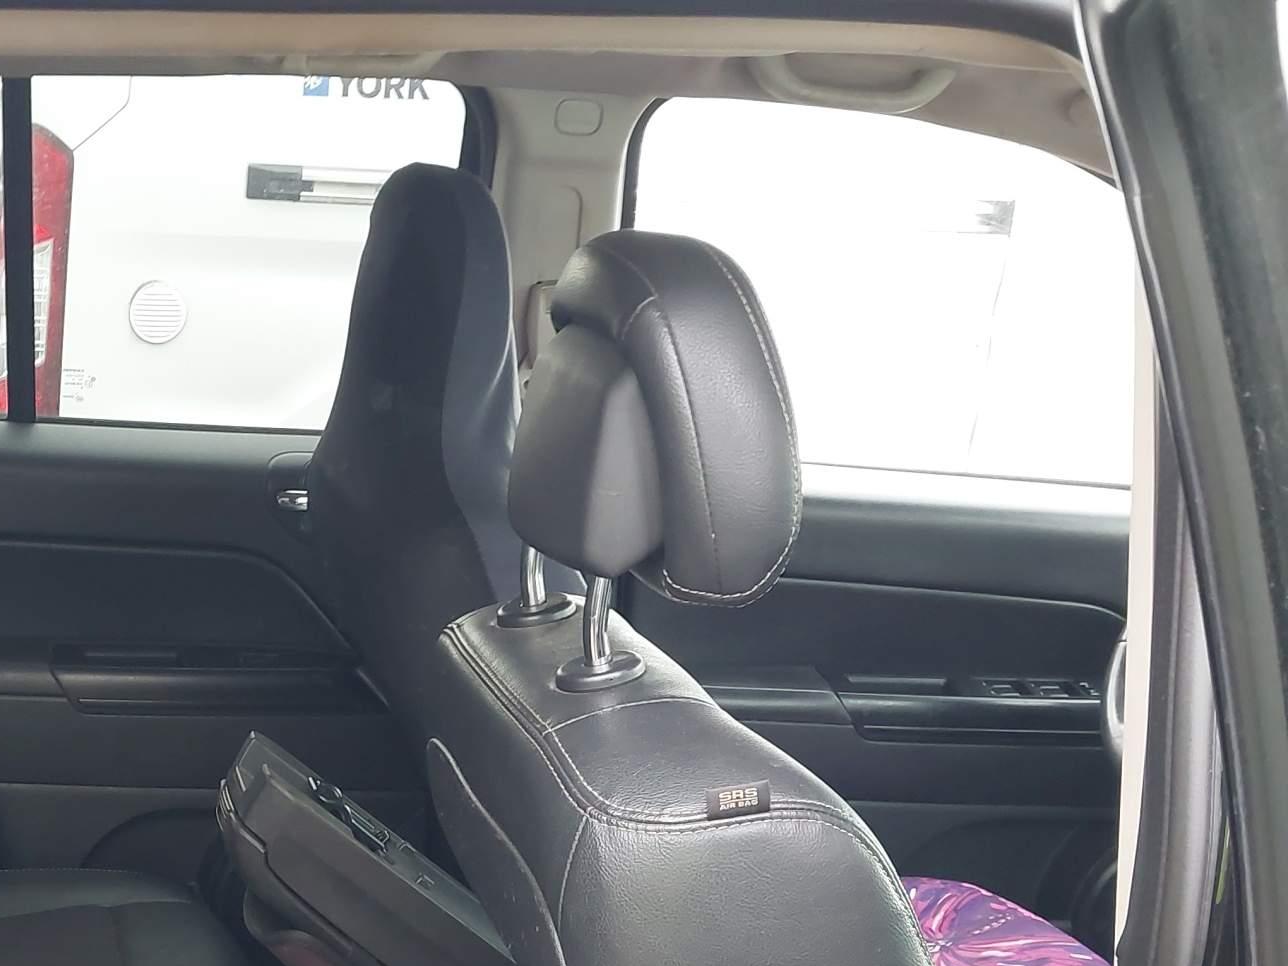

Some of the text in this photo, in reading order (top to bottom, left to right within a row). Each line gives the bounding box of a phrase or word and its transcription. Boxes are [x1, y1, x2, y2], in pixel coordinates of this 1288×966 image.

[340, 77, 429, 100] YORK
[718, 787, 758, 800] SRS
[719, 799, 759, 811] AIR BAG
